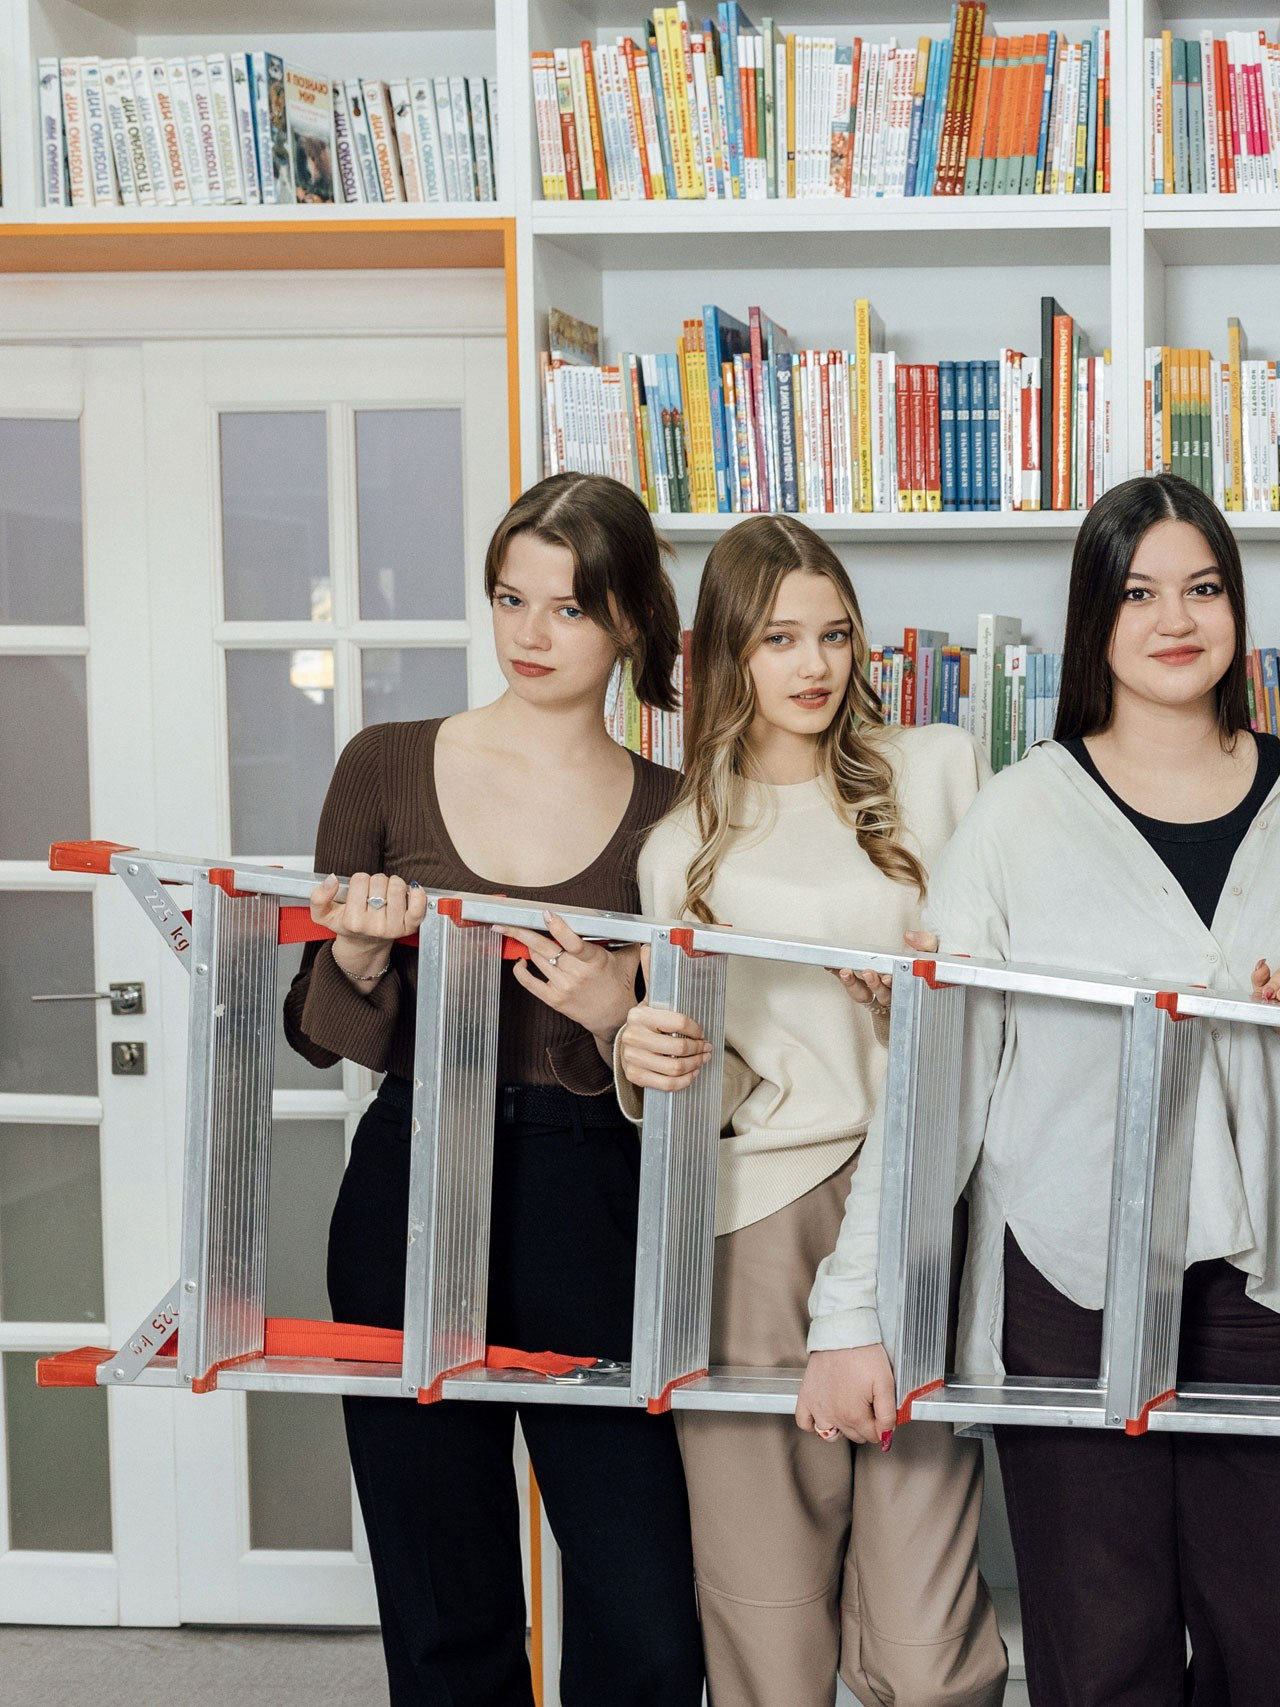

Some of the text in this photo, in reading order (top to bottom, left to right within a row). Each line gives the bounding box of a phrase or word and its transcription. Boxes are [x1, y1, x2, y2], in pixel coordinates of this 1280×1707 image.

[952, 32, 961, 57] ДРУГИЕ
[962, 33, 971, 57] ДРУГИЕ
[965, 7, 973, 32] СКАЗКИ
[1082, 43, 1090, 84] РАССКАЗЫ
[1079, 93, 1087, 122] СКАЗКИ
[65, 93, 84, 197] Я ПОЗНАЮ МИР
[87, 89, 110, 195] Я ПОЗНАЮ МИР
[109, 105, 133, 193] Я ПОЗНАЮ МИР
[121, 97, 151, 192] Я ПОЗНАЮ МИР
[158, 93, 186, 190] Я ПОЗНАЮ МИР
[196, 94, 220, 190] Я ПОЗНАЮ МИР
[335, 111, 357, 195] ПОЗНАЮ МИР
[371, 114, 394, 194] ПОЗНАЮ МИР
[939, 167, 945, 177] В.
[940, 135, 949, 166] БИАНКИ
[948, 167, 955, 177] В.
[950, 135, 959, 166] БИАНКИ
[779, 384, 794, 481] БОЛЬШАЯ СОБАЧЬЯ КНИГА
[144, 889, 190, 952] 225 kg
